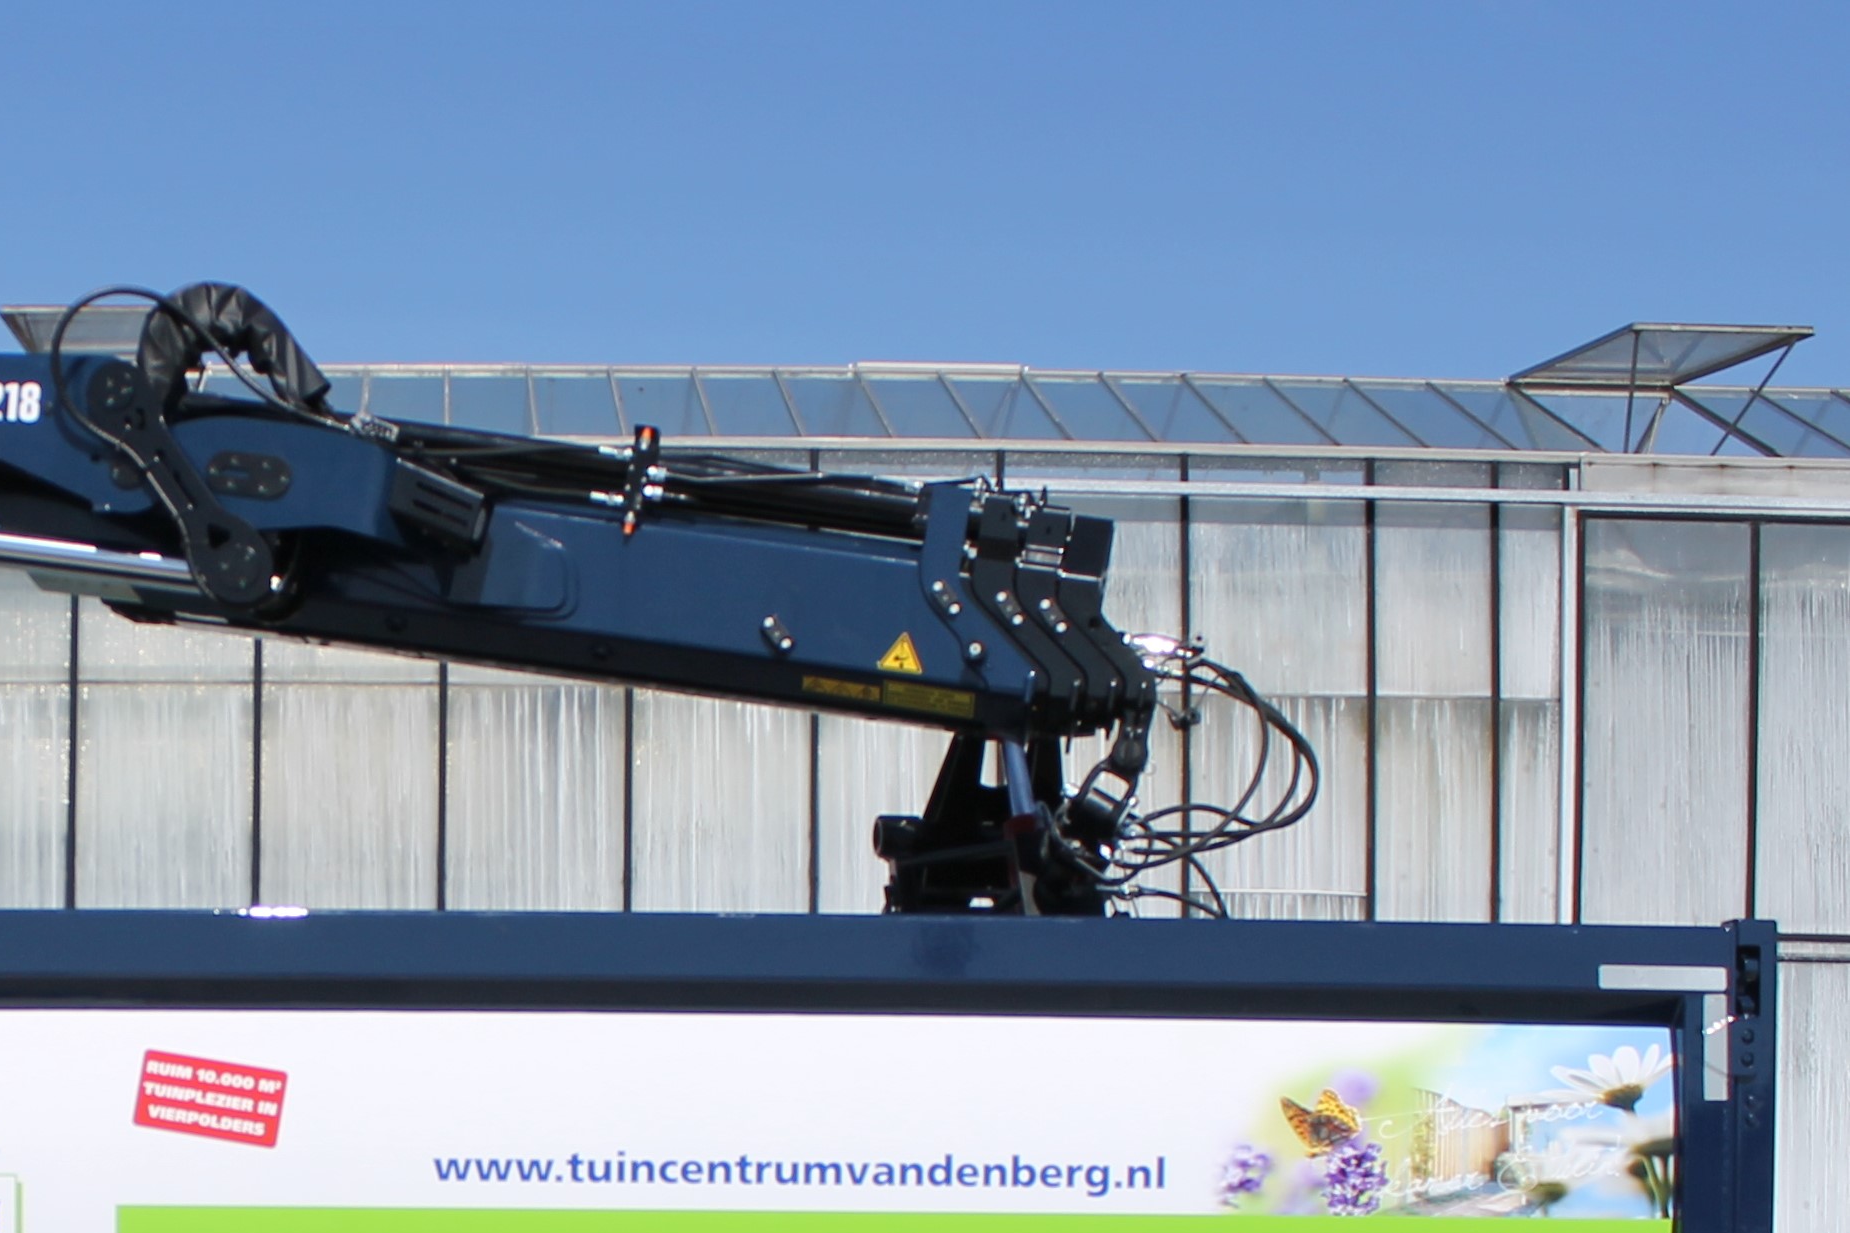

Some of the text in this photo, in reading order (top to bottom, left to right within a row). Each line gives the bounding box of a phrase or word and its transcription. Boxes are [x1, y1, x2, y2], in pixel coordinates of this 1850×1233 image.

[146, 1060, 193, 1080] RUIM
[196, 1068, 255, 1091] 10.000
[143, 1081, 279, 1117] TUINPLEZIER IN
[148, 1104, 266, 1137] VIERPOLDERS
[432, 1149, 1168, 1198] www.tuincentrumvandenberg.nl
